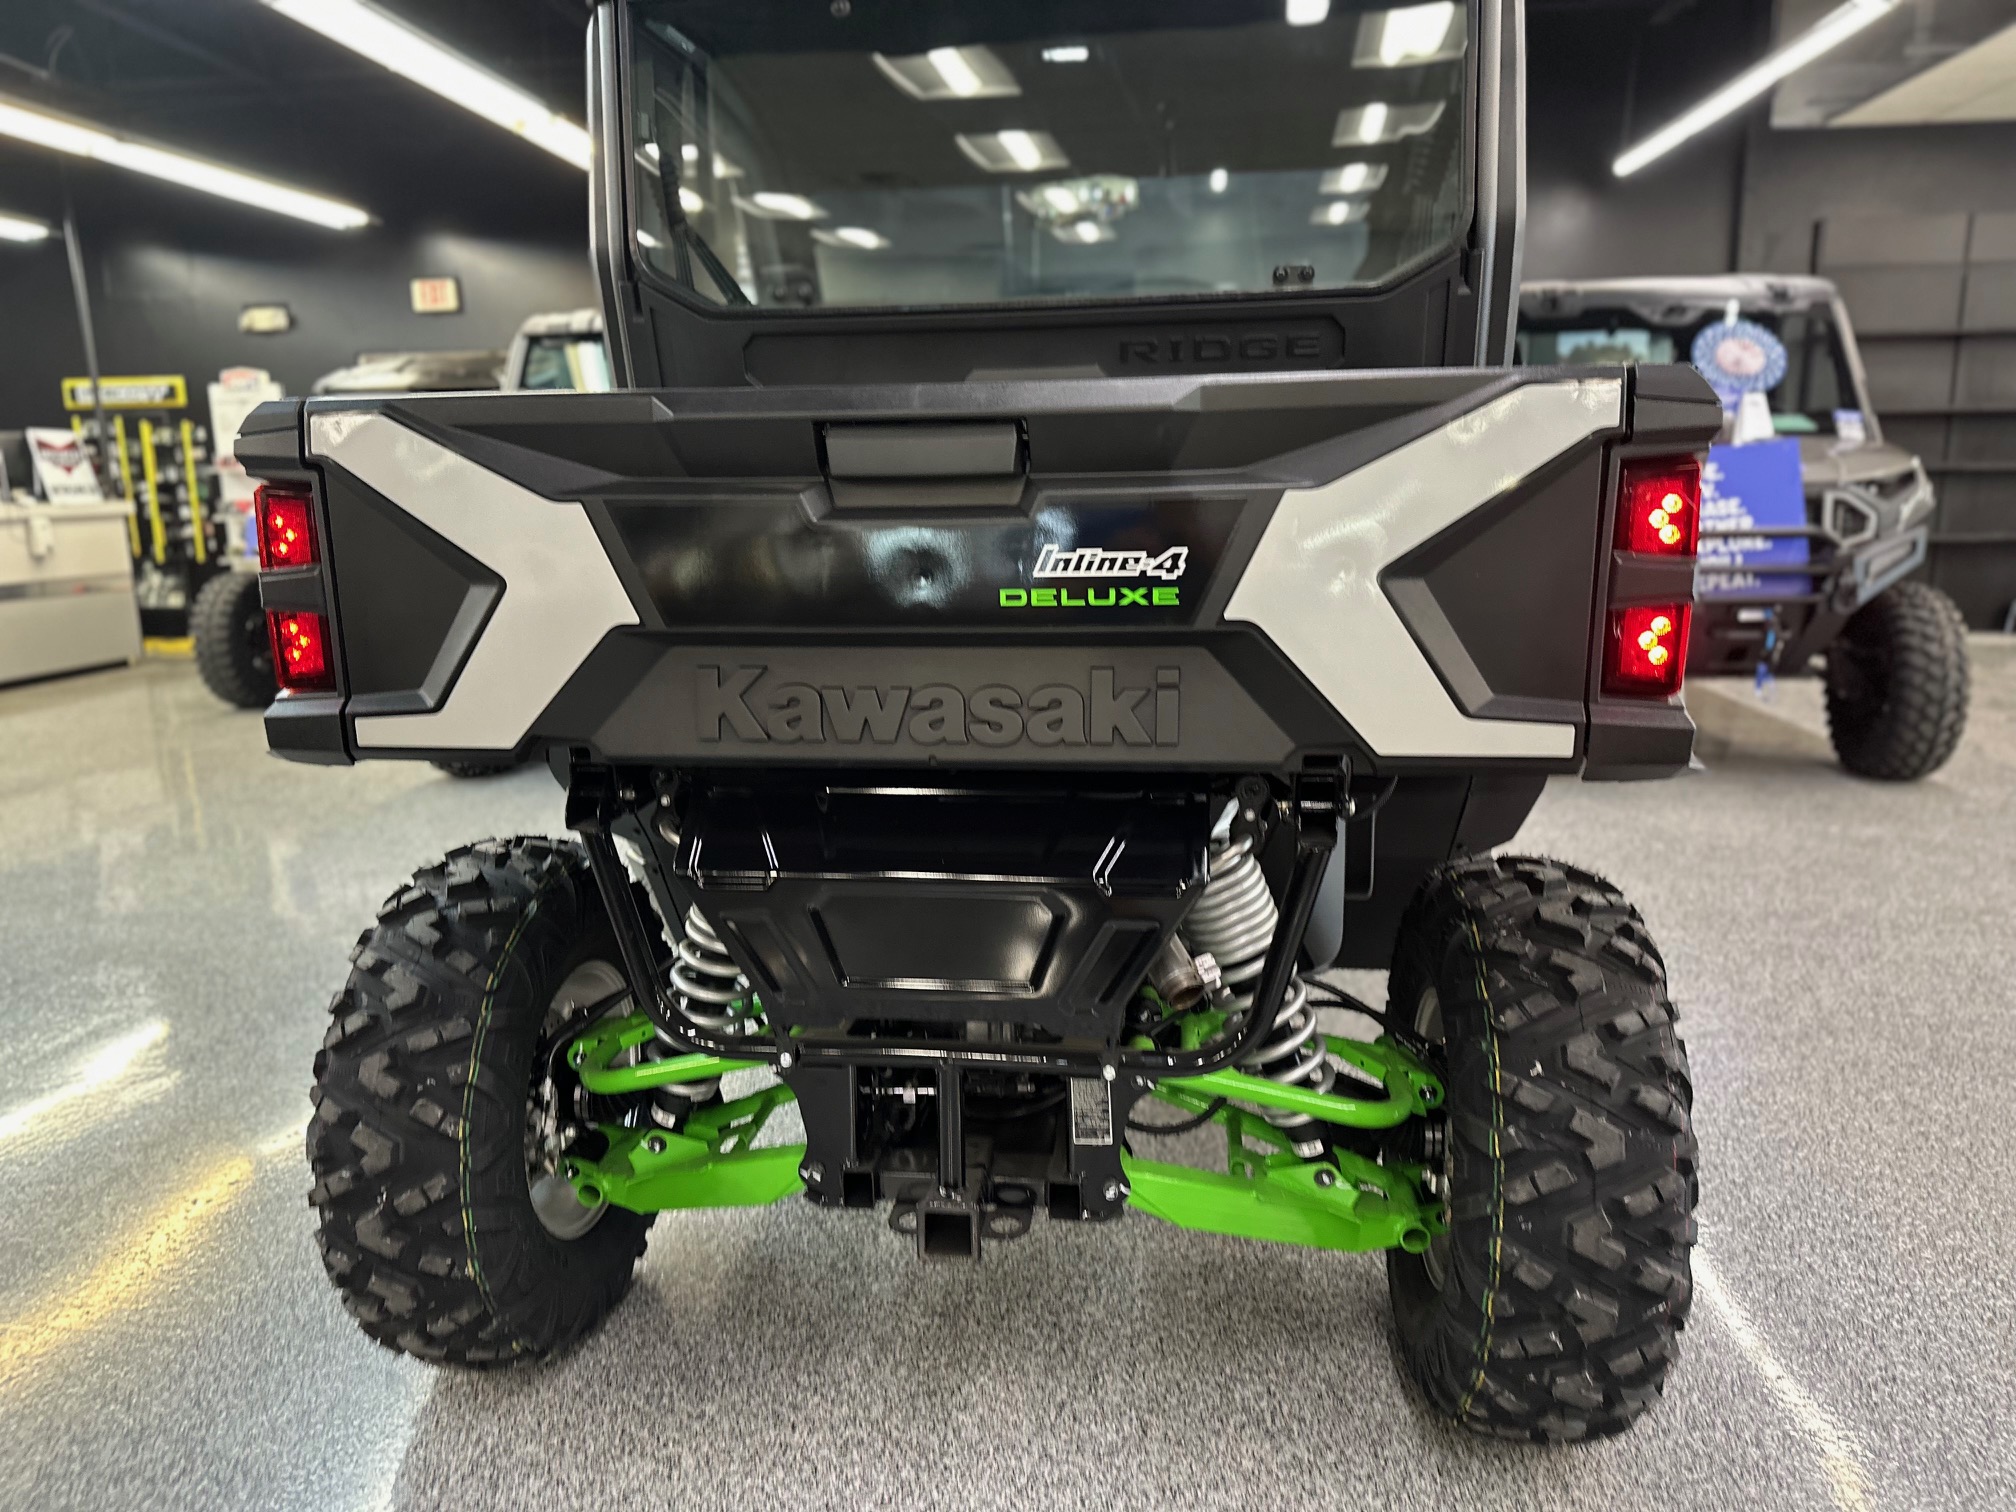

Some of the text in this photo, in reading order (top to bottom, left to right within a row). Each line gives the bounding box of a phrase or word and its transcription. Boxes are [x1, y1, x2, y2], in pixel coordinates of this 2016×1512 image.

[1118, 333, 1322, 365] RIDGE
[1033, 543, 1189, 580] Inline-4
[999, 586, 1180, 607] DELUXE
[696, 664, 1181, 747] Kawasaki
